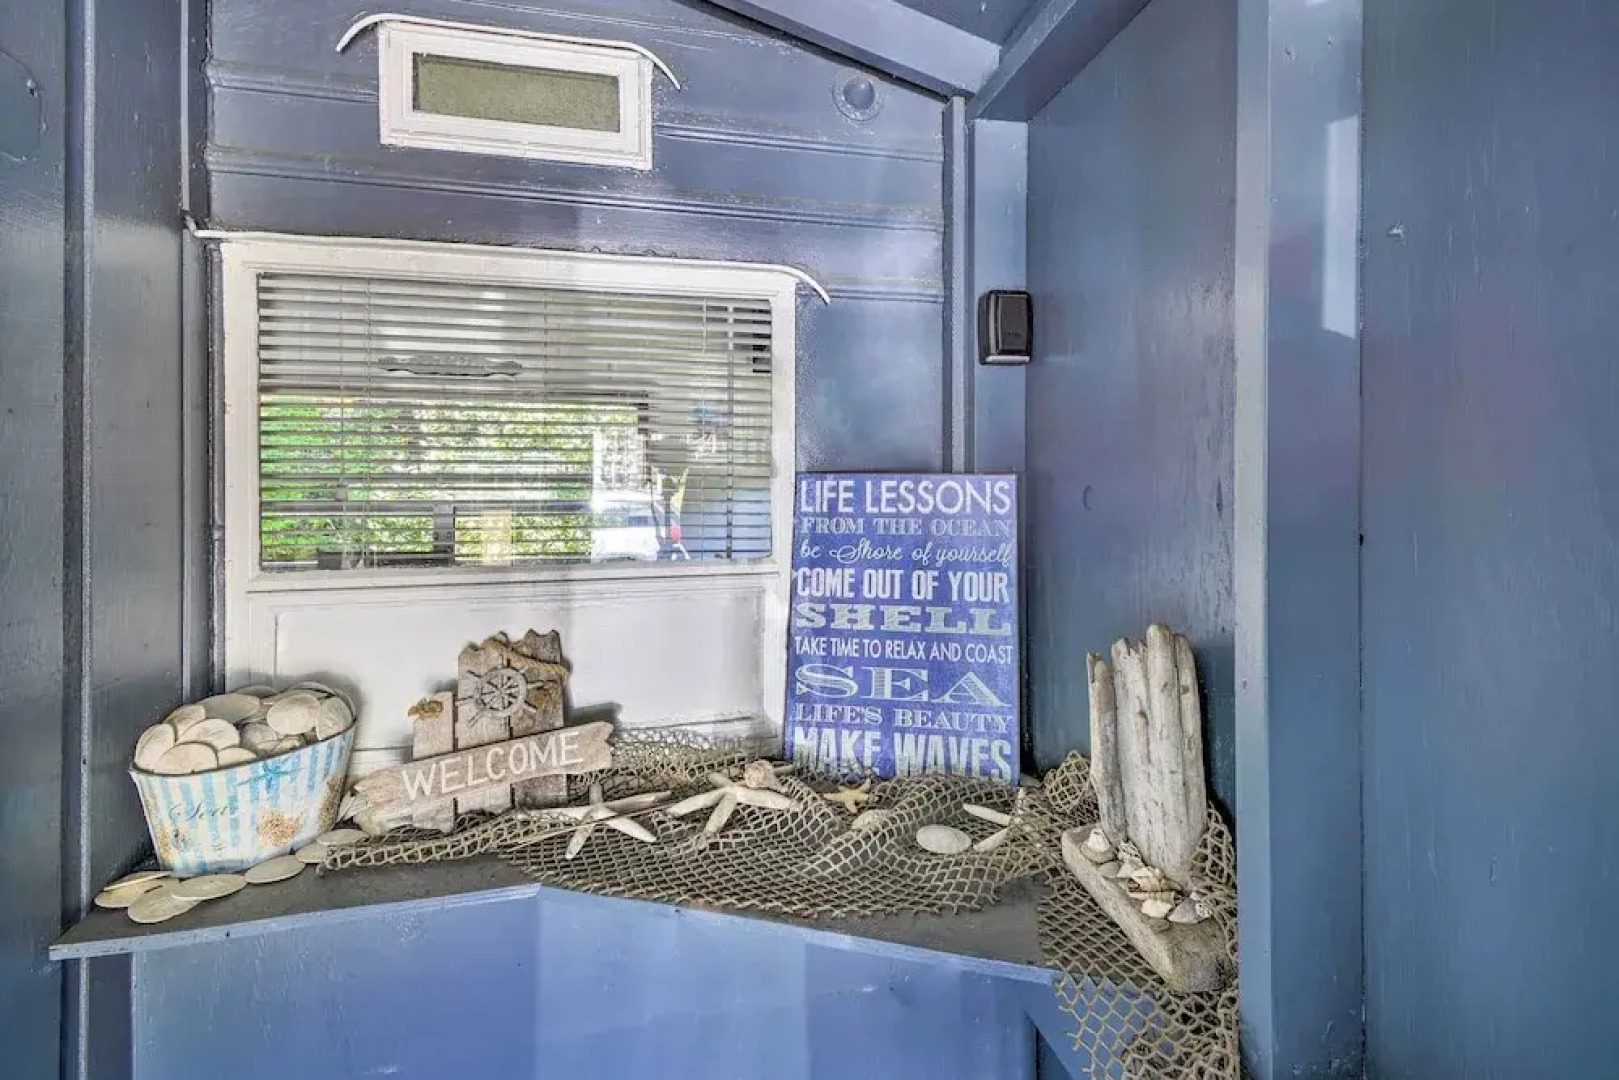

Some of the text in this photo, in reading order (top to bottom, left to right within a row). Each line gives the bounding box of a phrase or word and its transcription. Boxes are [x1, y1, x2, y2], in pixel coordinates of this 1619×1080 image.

[800, 480, 1011, 515] LIFE LESSONS
[800, 517, 1013, 537] FROM THE OCEAN
[800, 538, 1013, 567] be Shore of yourself
[797, 567, 1010, 603] COME OUT OF YOUR
[796, 602, 1012, 636] SHELL
[795, 636, 1013, 665] TAKE TIME TO RELAX AND COAST
[795, 663, 1012, 707] SEA
[795, 703, 1012, 733] LIFE'S BEAUTY
[402, 731, 584, 801] WELCOME
[793, 726, 1012, 785] MAKE WAVES
